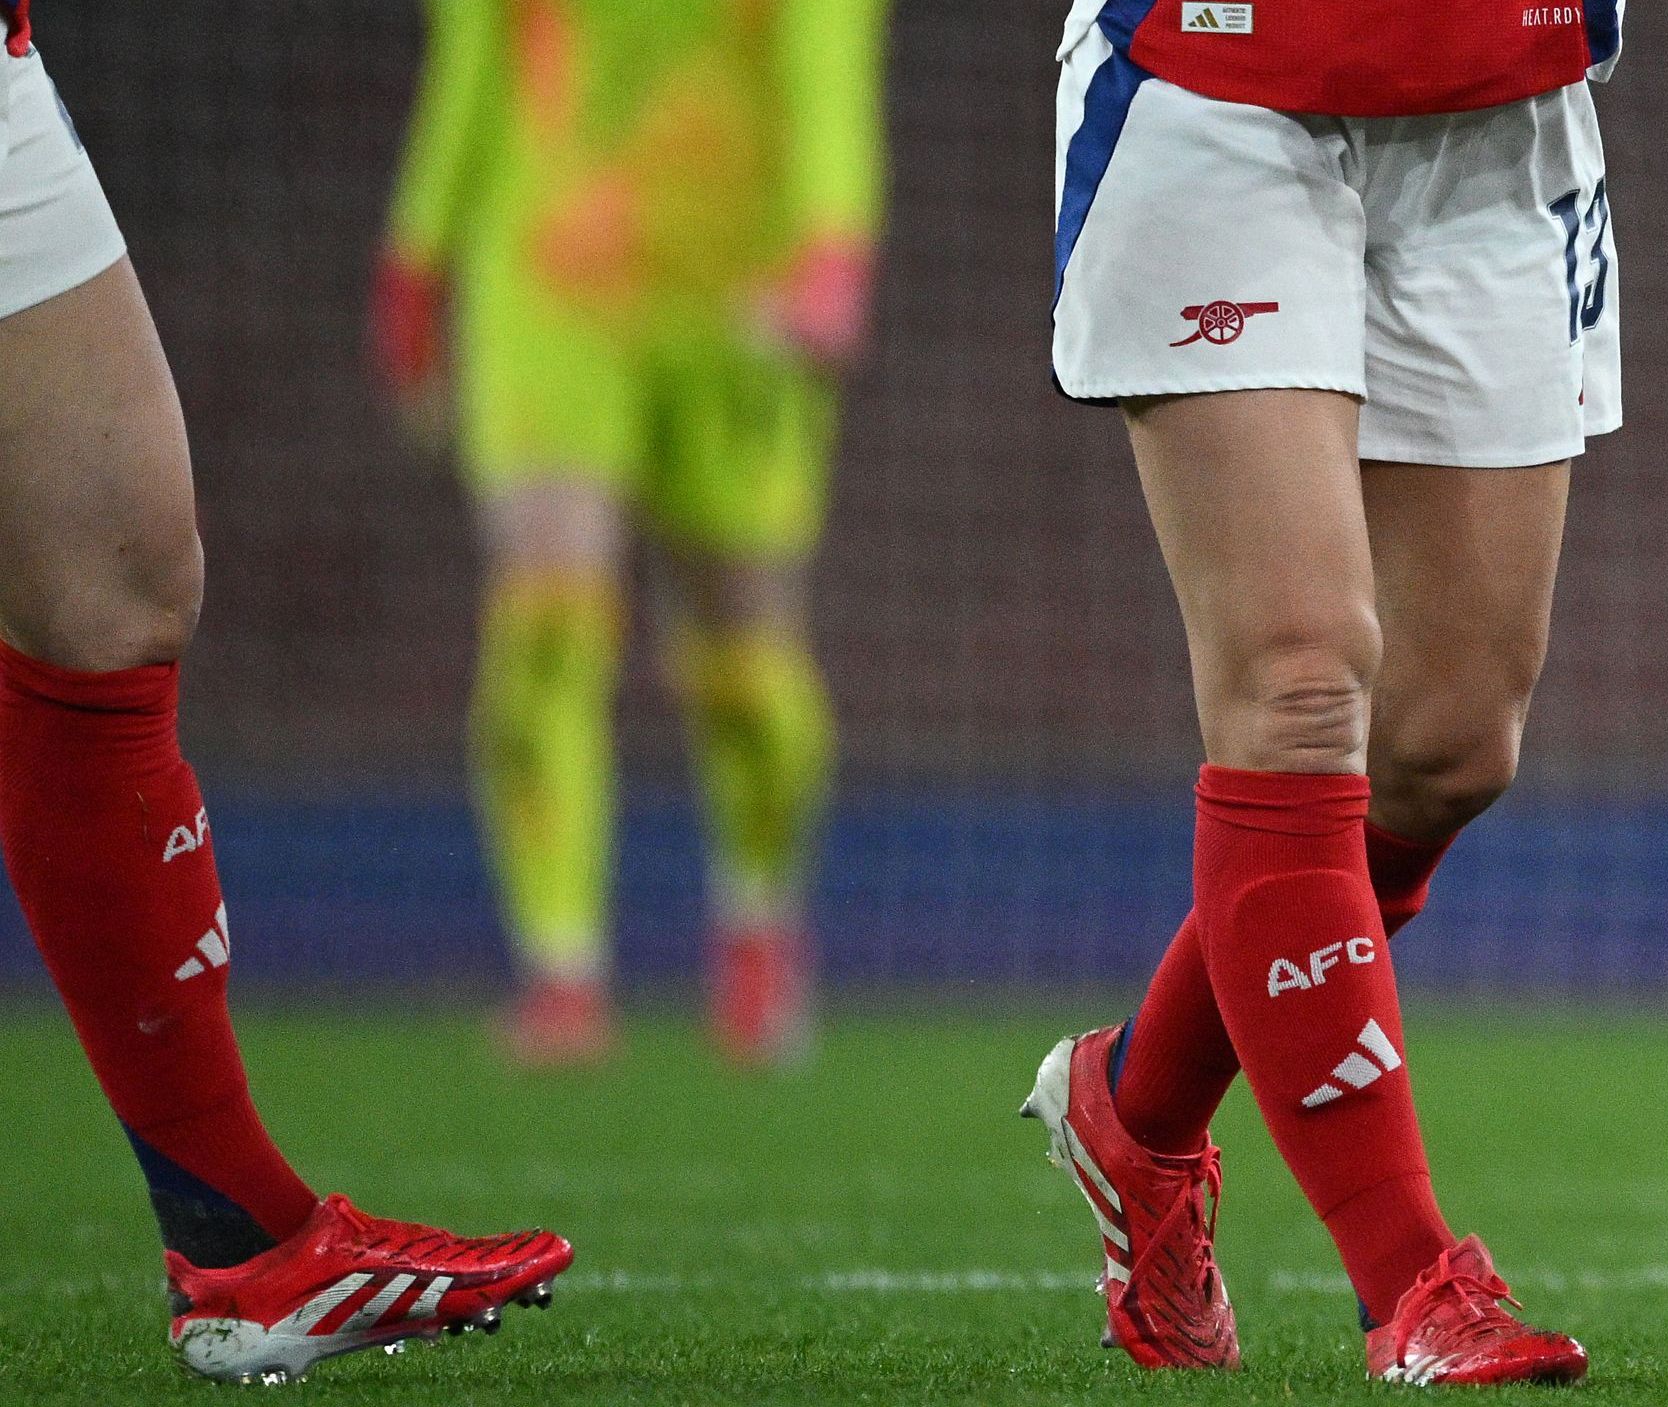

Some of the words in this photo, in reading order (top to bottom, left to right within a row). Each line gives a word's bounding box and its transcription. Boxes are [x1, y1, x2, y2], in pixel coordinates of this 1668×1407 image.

[1522, 6, 1582, 27] HEAT.RDY
[1547, 174, 1608, 348] 13
[162, 805, 210, 863] AF
[1267, 936, 1375, 998] AFC
